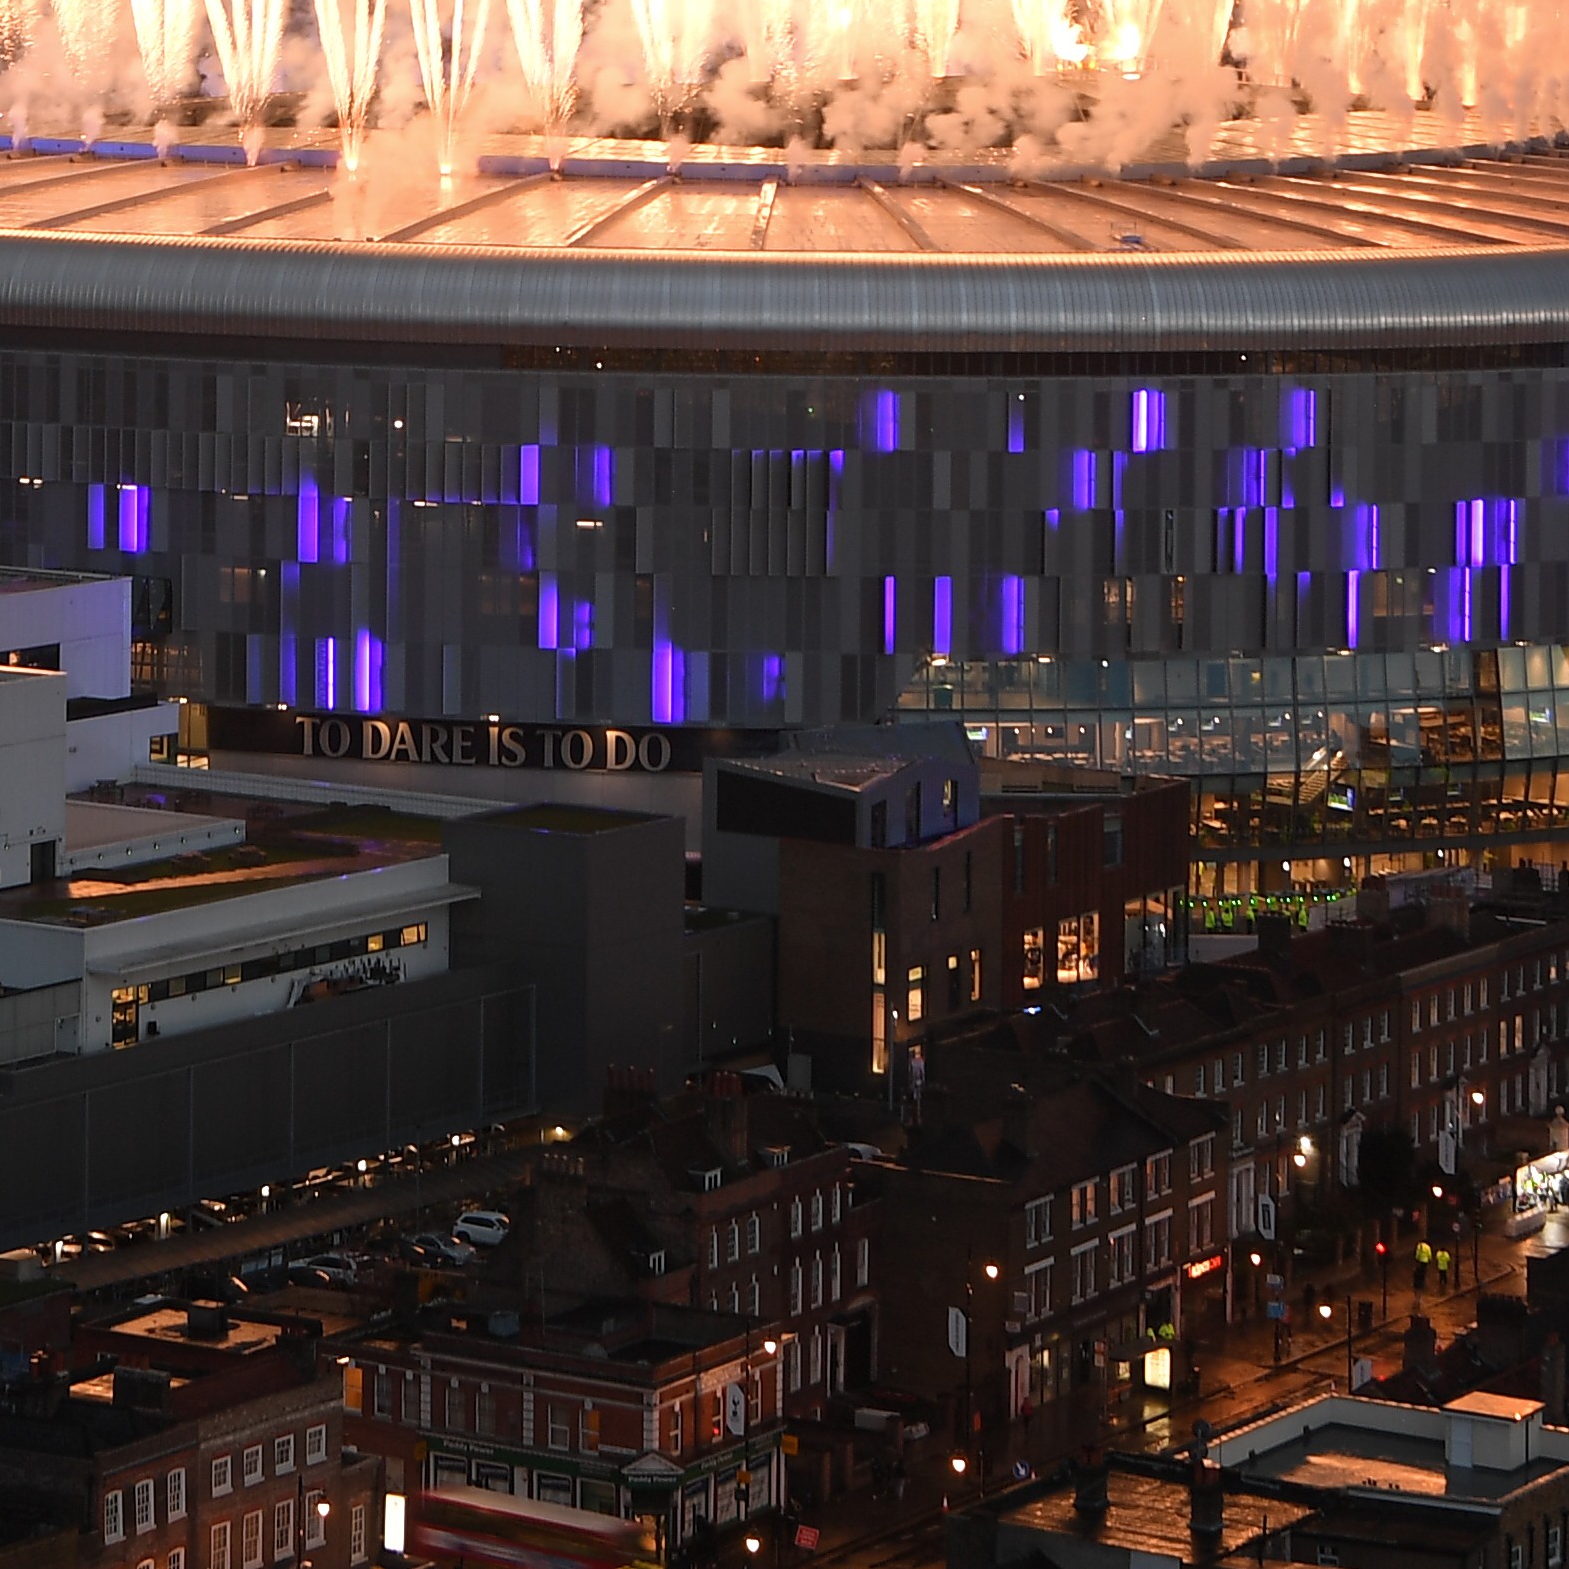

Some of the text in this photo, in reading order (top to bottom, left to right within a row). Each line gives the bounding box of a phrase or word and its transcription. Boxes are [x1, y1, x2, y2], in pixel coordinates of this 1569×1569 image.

[295, 715, 672, 772] TO DARE IS TO DO
